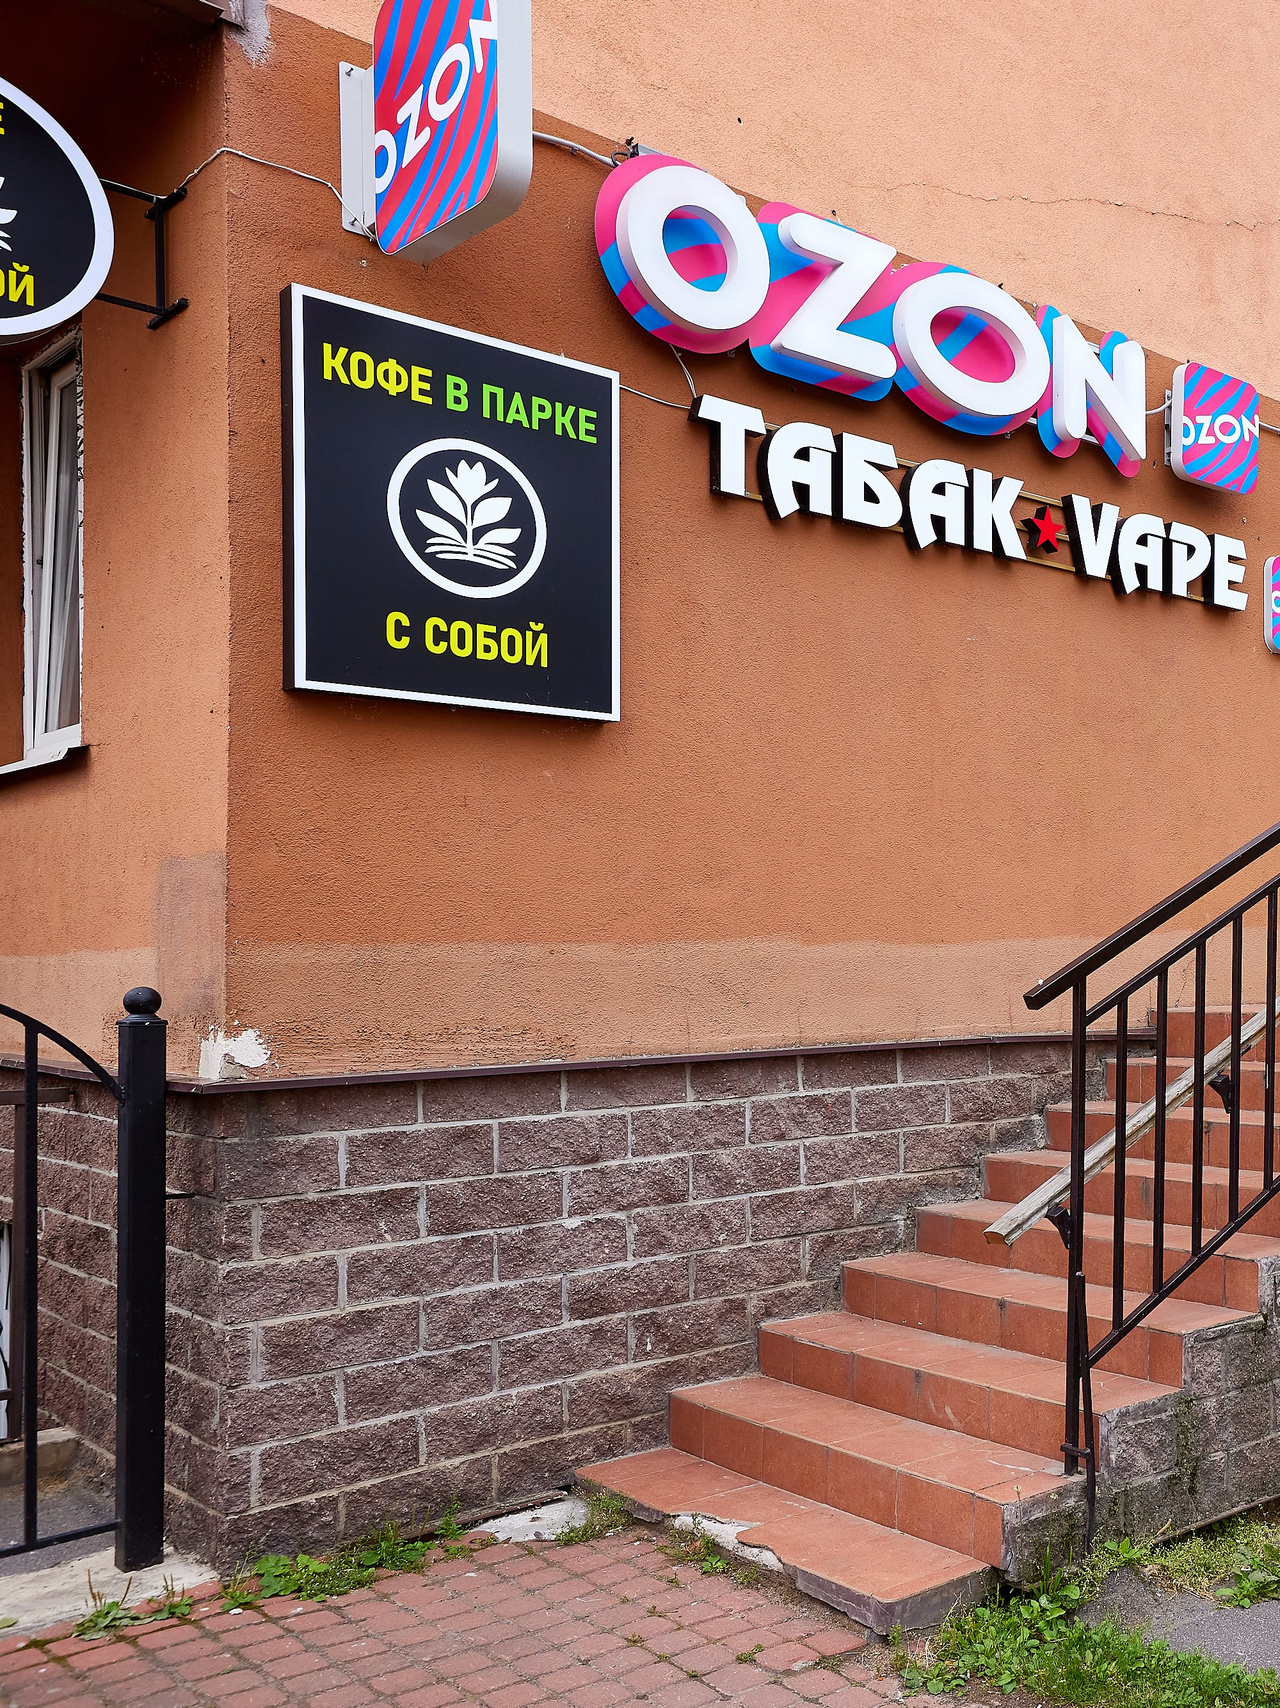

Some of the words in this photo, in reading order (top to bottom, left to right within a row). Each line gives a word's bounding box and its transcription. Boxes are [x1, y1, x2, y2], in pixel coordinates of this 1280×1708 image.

[375, 0, 498, 194] OZON
[615, 164, 1147, 462] OZON
[321, 342, 433, 406] КОФЕ
[446, 381, 469, 413] В
[482, 385, 598, 445] ПАРКЕ
[1182, 413, 1260, 446] OZON
[690, 394, 1028, 562] ТАБАК
[1063, 494, 1249, 611] VAPE
[386, 612, 411, 650] С
[424, 617, 549, 669] СОБОЙ
